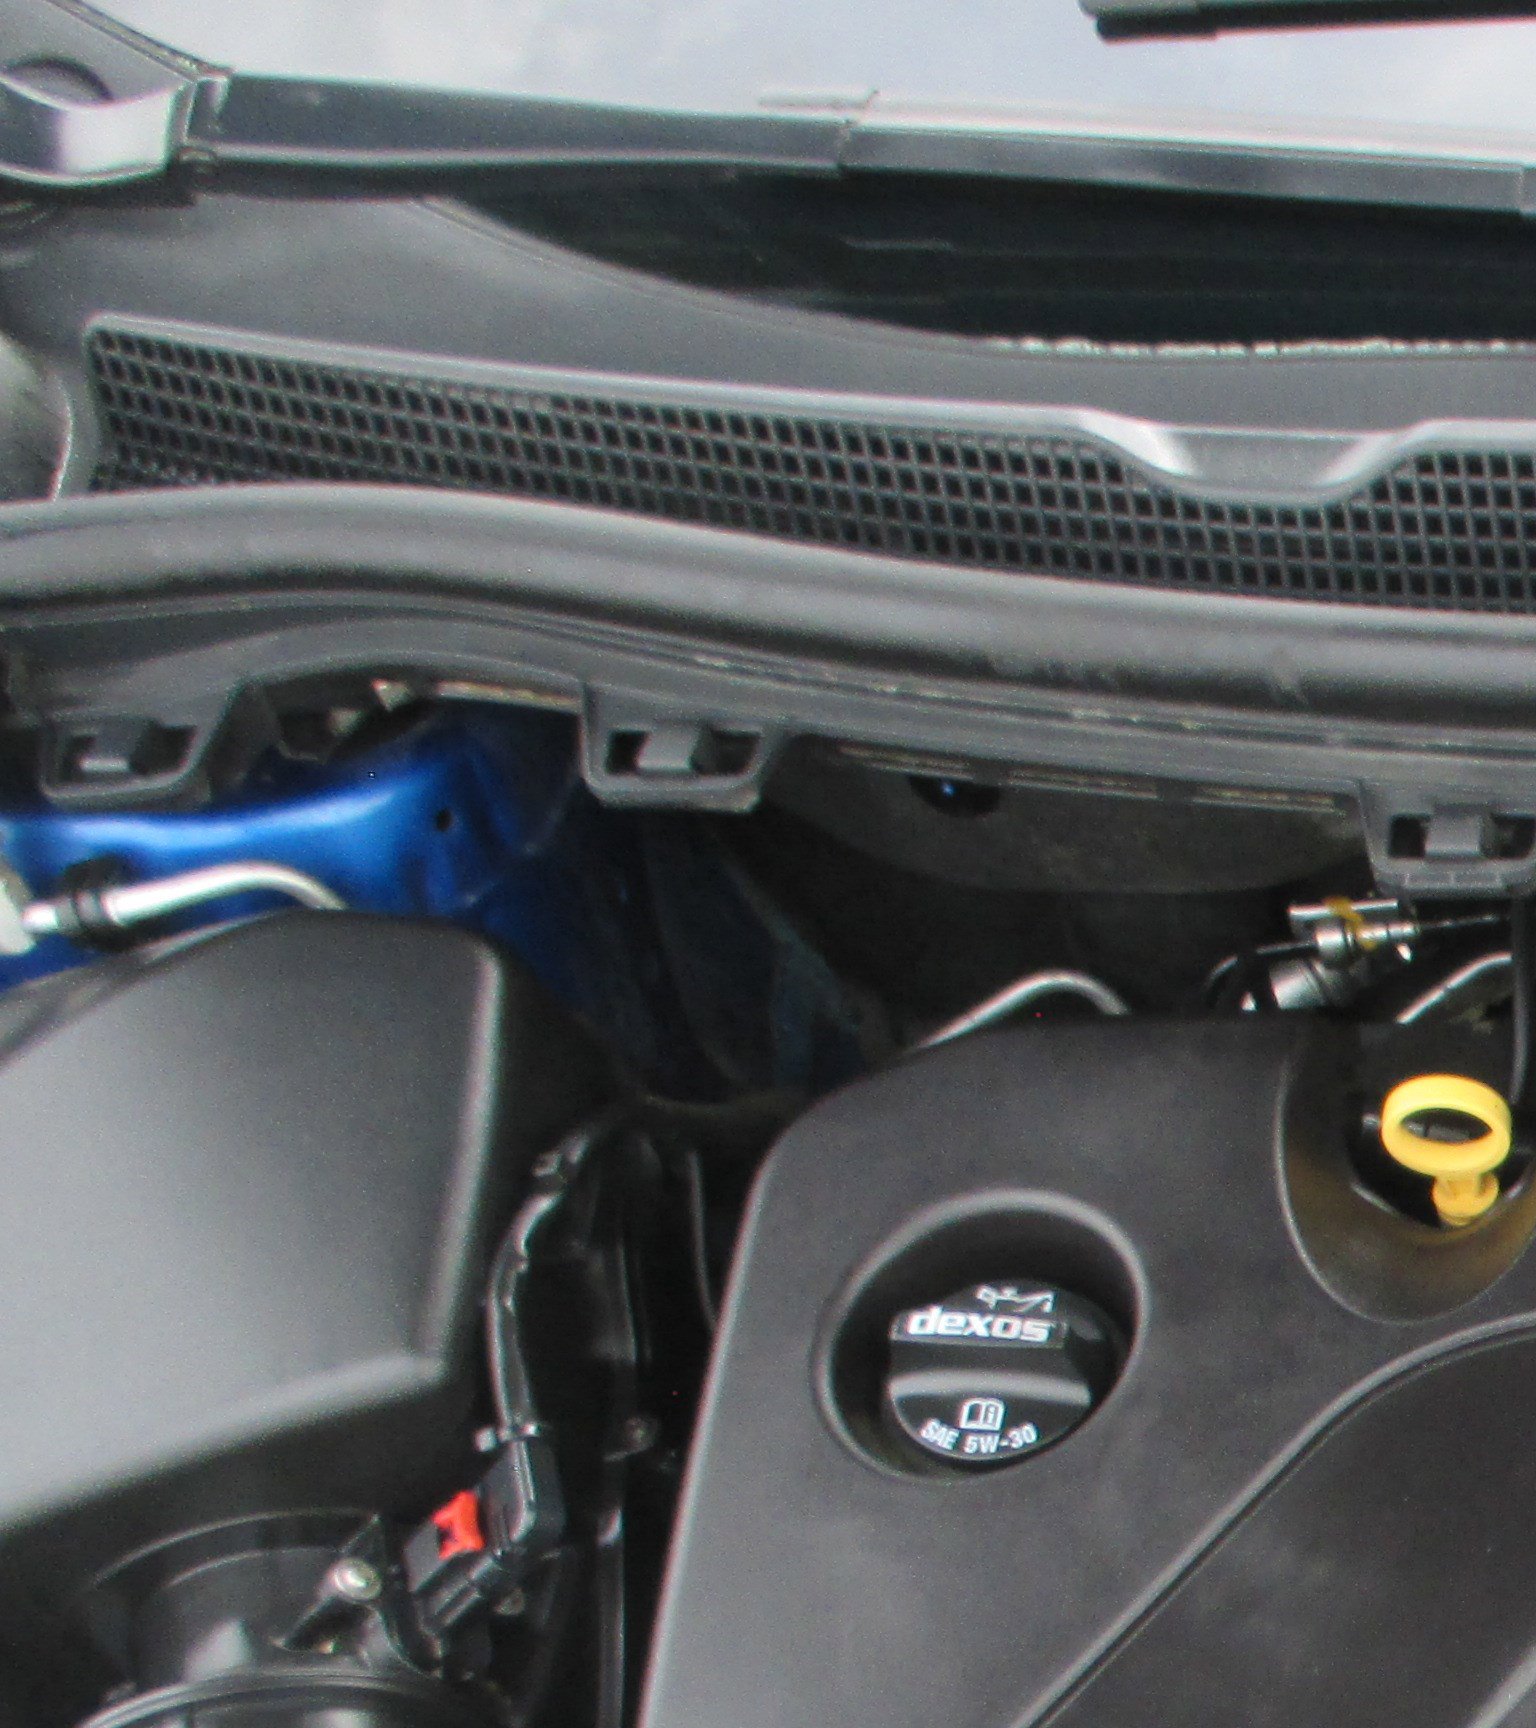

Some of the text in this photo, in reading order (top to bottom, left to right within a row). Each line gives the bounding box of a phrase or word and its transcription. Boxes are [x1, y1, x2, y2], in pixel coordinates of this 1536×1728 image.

[907, 1306, 1054, 1342] dexos
[920, 1417, 1039, 1454] SAE 5W-30
